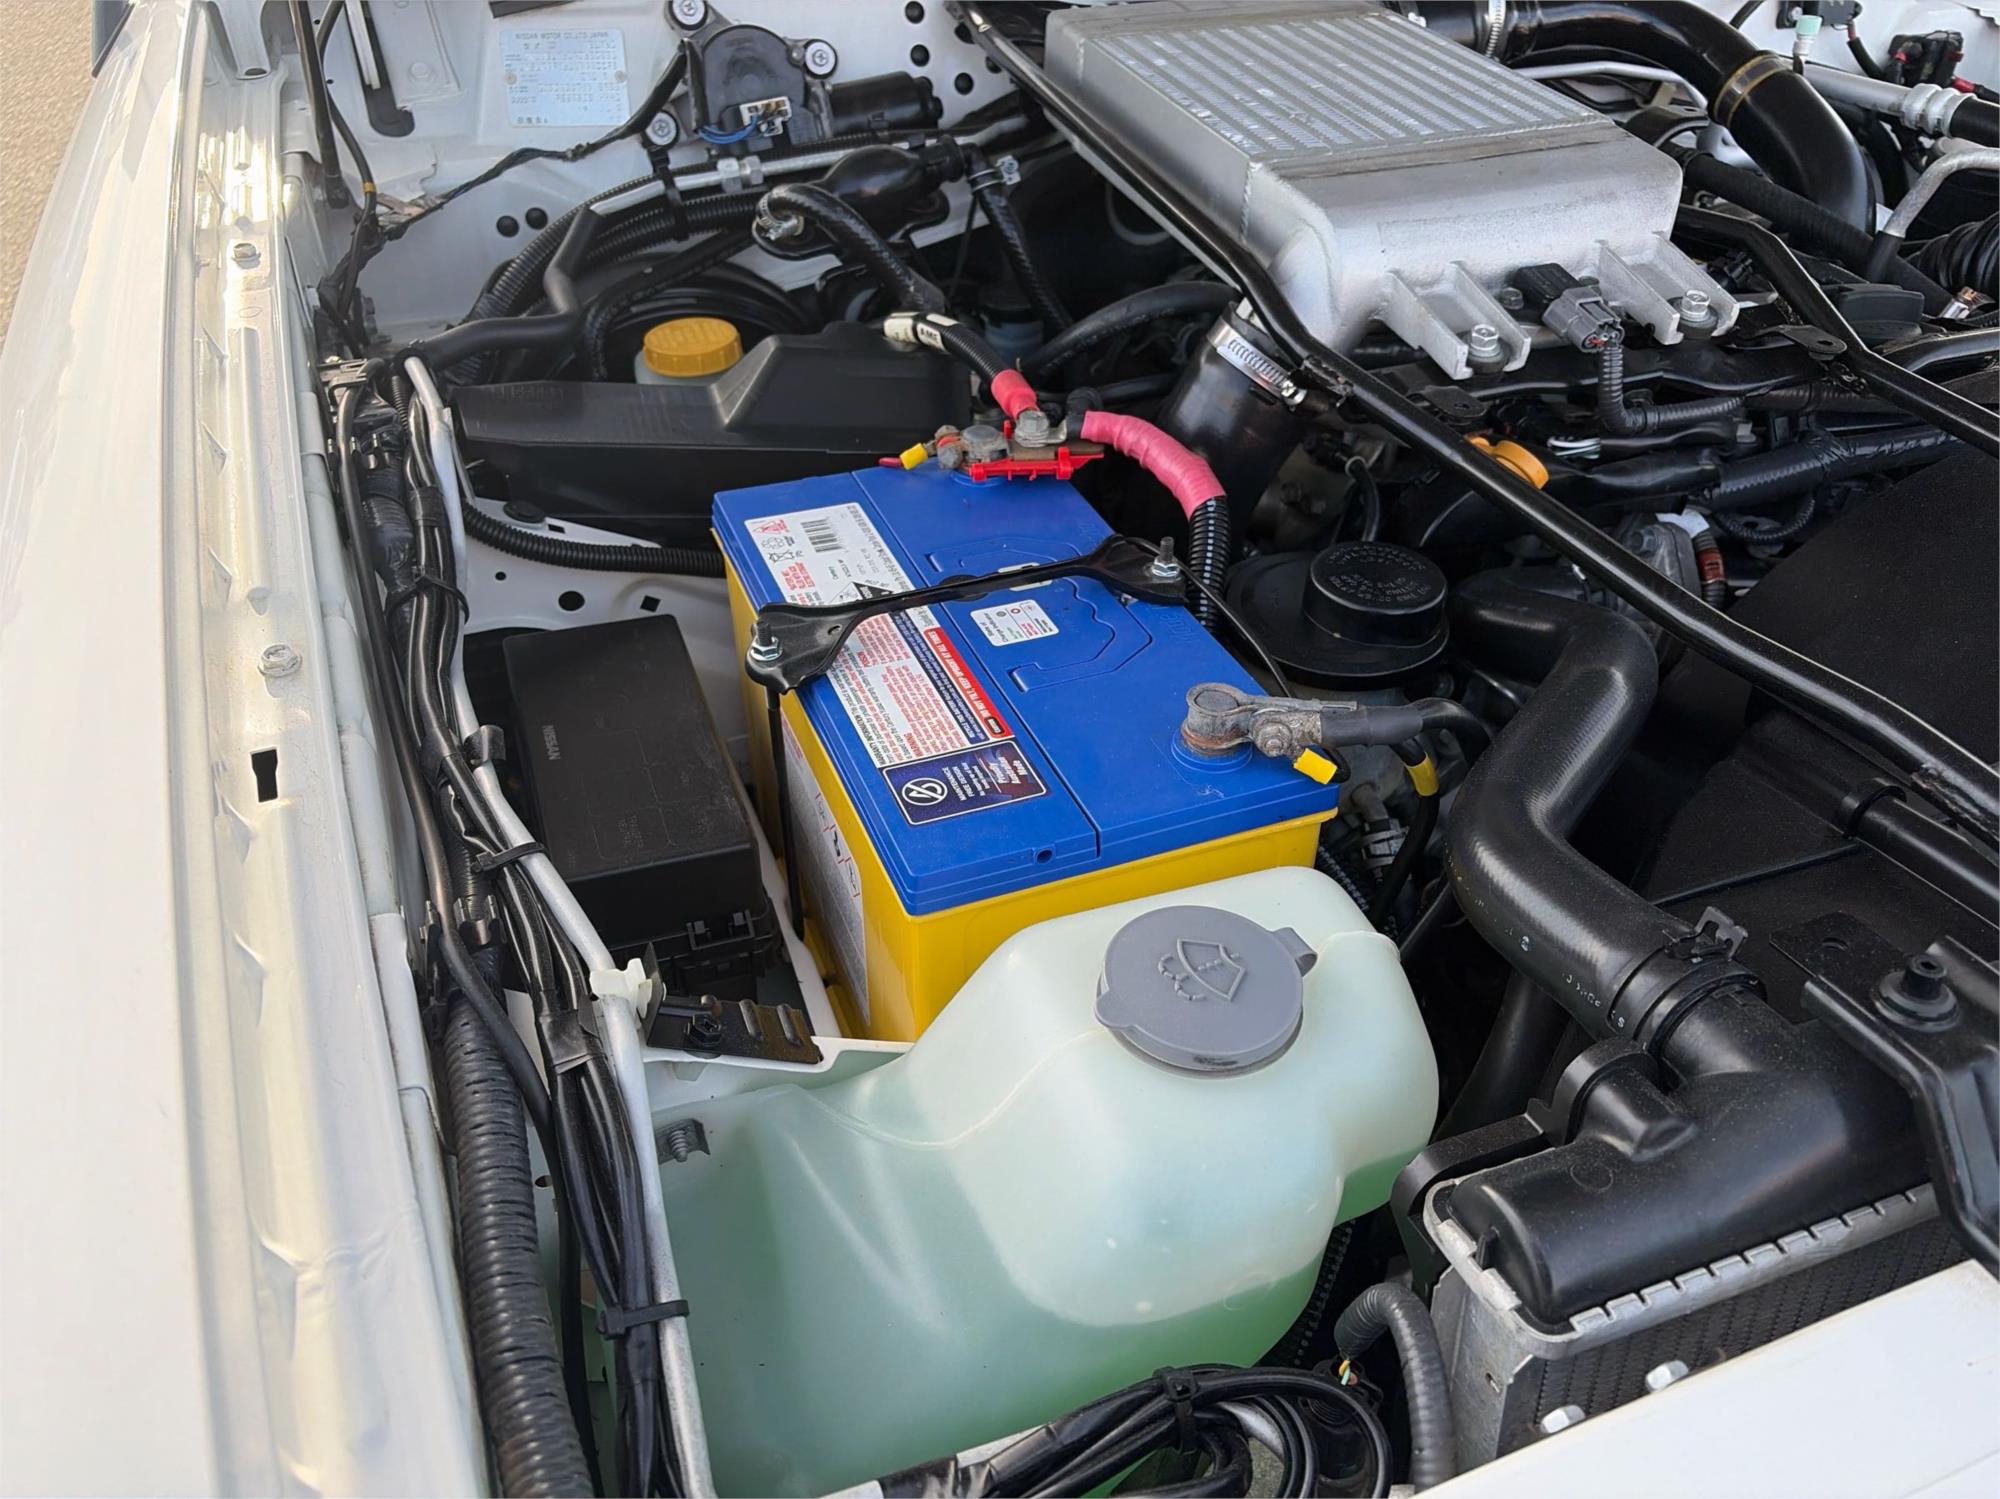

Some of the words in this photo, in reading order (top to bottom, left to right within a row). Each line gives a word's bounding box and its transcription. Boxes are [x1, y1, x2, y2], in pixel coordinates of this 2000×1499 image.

[983, 612, 998, 629] Indicator
[995, 628, 1008, 642] Charge
[937, 644, 947, 652] ALL
[857, 651, 870, 667] POISON
[946, 658, 963, 677] UPRIGHT
[958, 676, 971, 688] KEEP
[947, 699, 960, 714] BATTERY
[974, 700, 985, 710] NOT
[980, 709, 990, 717] DO
[956, 714, 965, 722] THIS
[854, 714, 873, 742] INFORMATION
[962, 722, 975, 738] RECYCLE
[541, 724, 562, 761] NISSAN
[904, 732, 923, 757] WARNING
[869, 741, 886, 765] WARRANTY
[952, 765, 966, 784] DESIGN
[988, 762, 1008, 784] Proudly
[996, 755, 1020, 785] Australian
[1011, 759, 1027, 776] Made
[942, 766, 966, 801] MAINTENANCE
[963, 783, 974, 797] FREE
